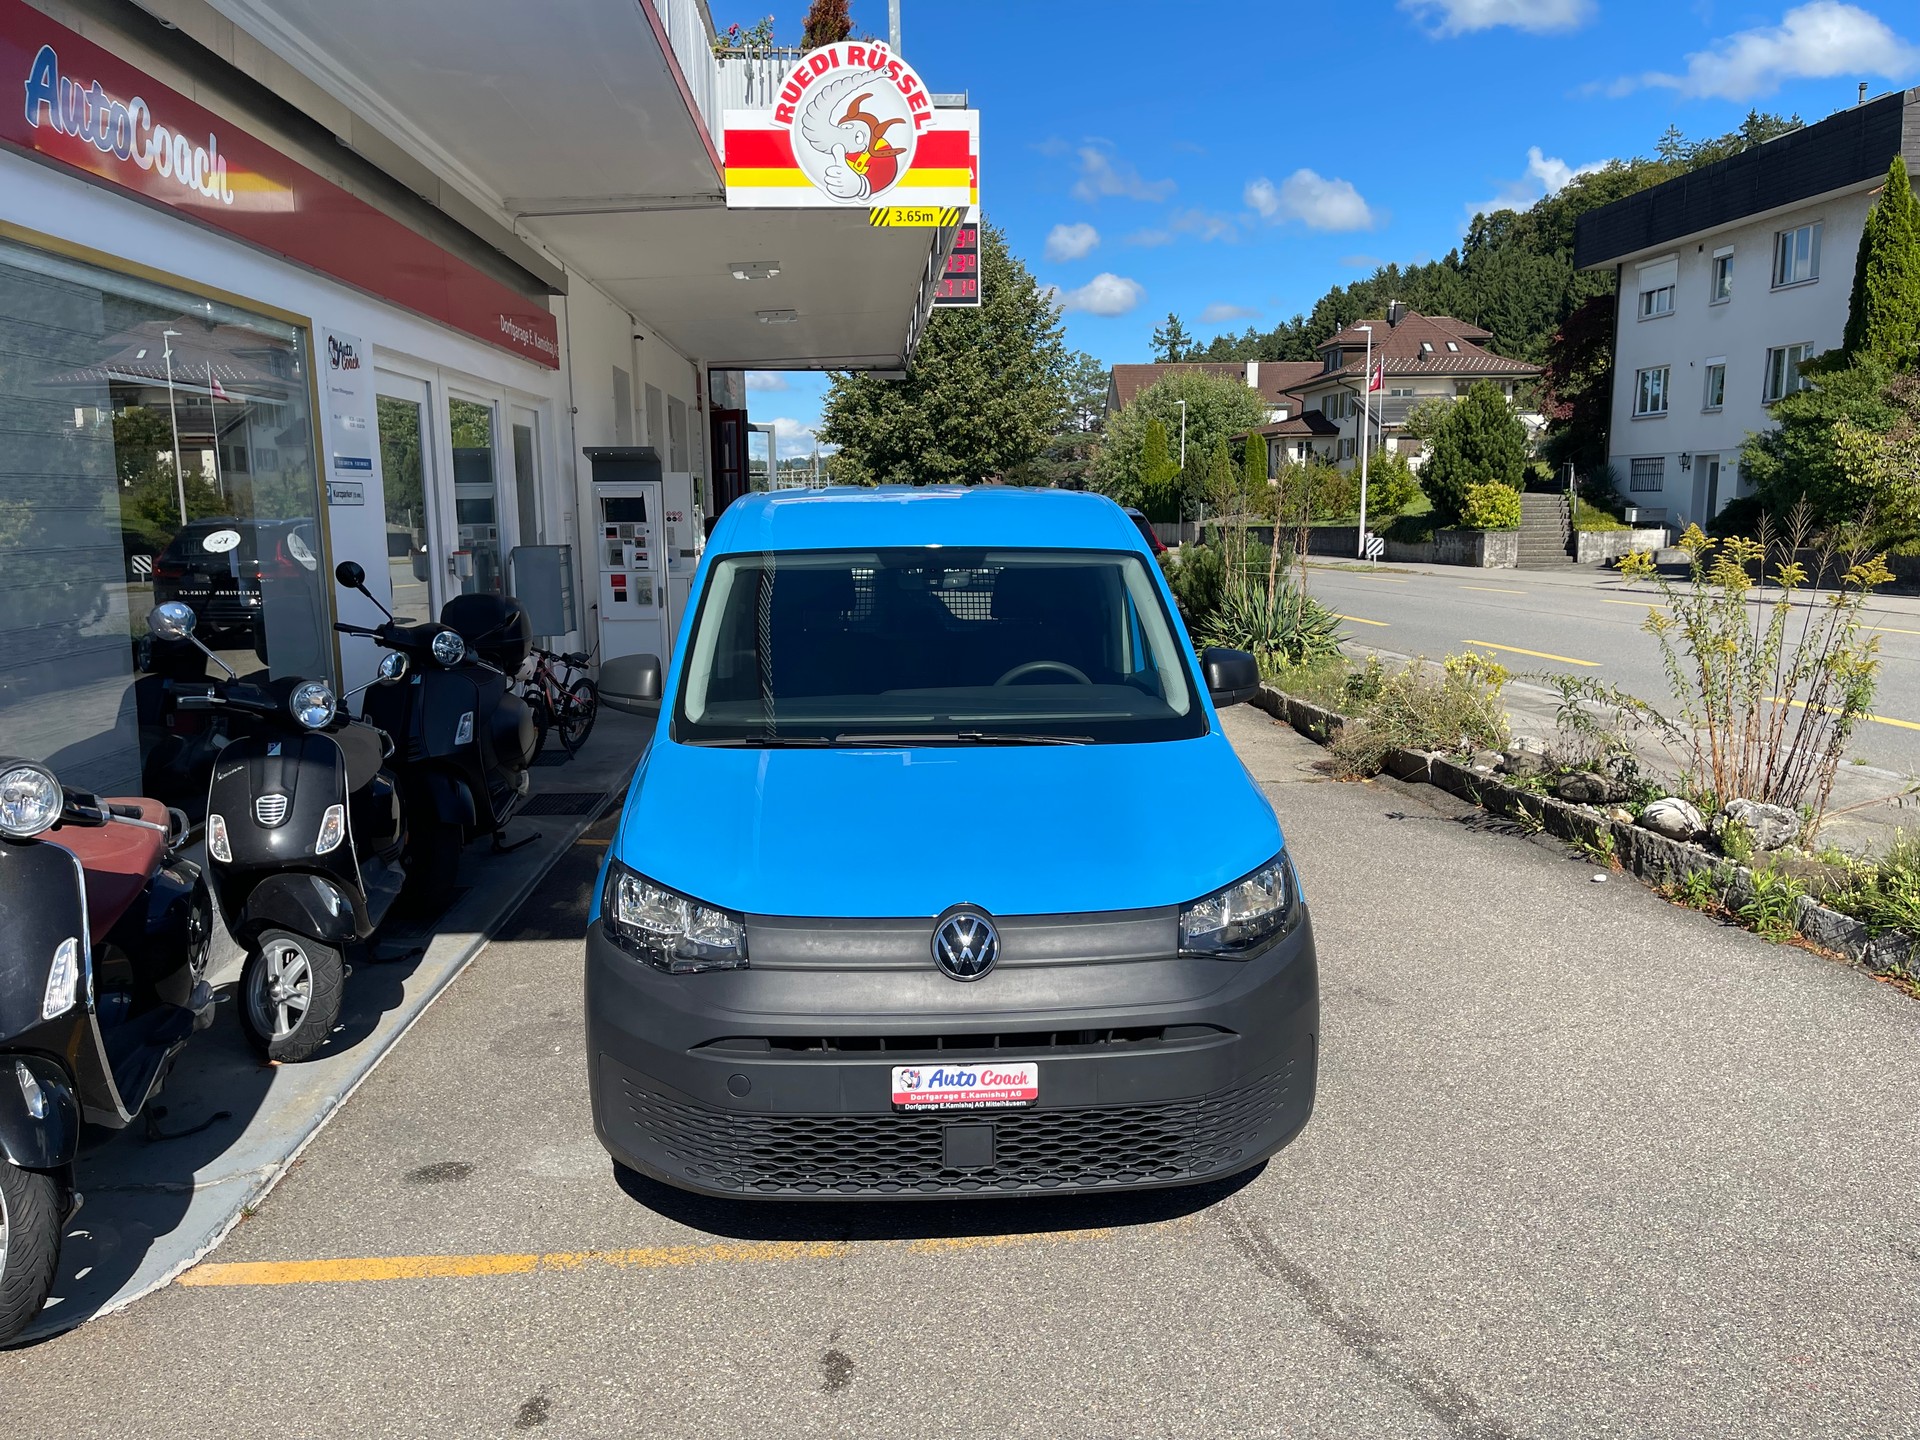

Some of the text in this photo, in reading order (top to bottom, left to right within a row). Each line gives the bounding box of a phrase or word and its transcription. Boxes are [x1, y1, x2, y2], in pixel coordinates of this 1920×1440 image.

[775, 43, 933, 131] RUEDI RÜSSEL
[895, 210, 934, 223] 3.65m
[499, 313, 529, 347] Dorfgarage
[927, 1068, 1029, 1089] Auto Coach
[910, 1092, 959, 1102] Dorfgarage
[1010, 1090, 1022, 1098] AG
[904, 1102, 939, 1111] Dorfgarage
[974, 1101, 985, 1109] AG
